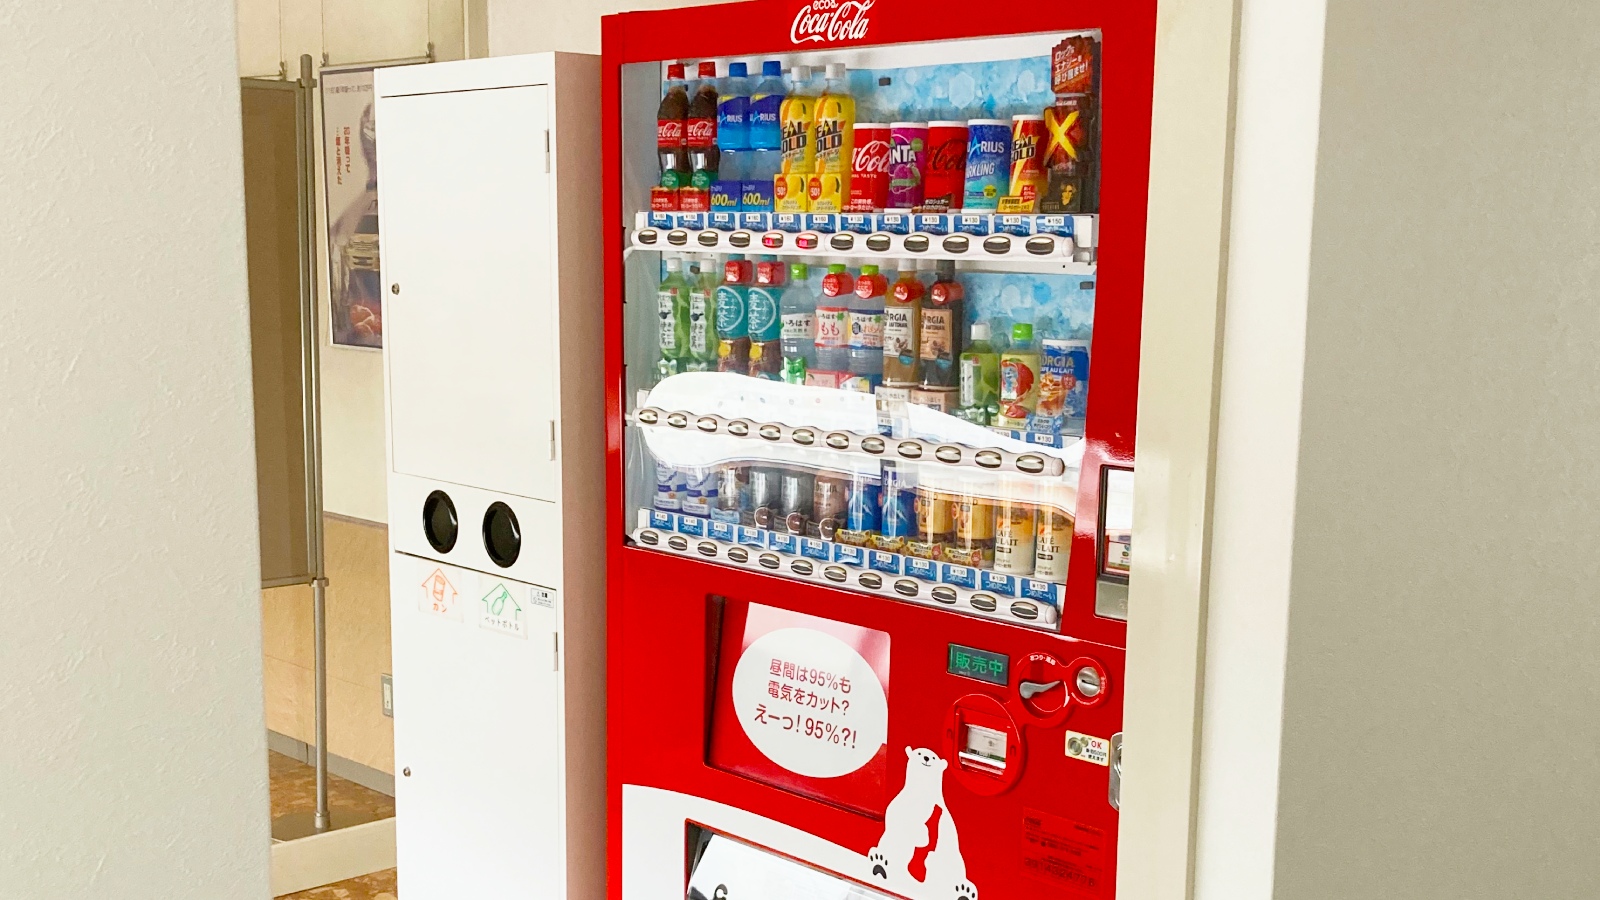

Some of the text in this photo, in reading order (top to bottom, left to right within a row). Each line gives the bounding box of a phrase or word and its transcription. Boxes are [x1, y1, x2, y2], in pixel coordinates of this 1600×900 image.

[790, 0, 876, 44] Coca-Cola
[782, 121, 807, 139] EAL
[816, 120, 839, 139] EAL
[782, 134, 807, 154] OLD
[816, 133, 842, 154] OLD
[748, 292, 762, 330] 麦茶
[820, 322, 840, 335] もも
[433, 603, 447, 613] カン
[485, 616, 520, 631] ペットボトル
[955, 651, 1003, 676] 販売中
[769, 658, 851, 694] 昼間は95%も
[767, 680, 850, 716] 電気をカット?
[1091, 740, 1102, 749] OK
